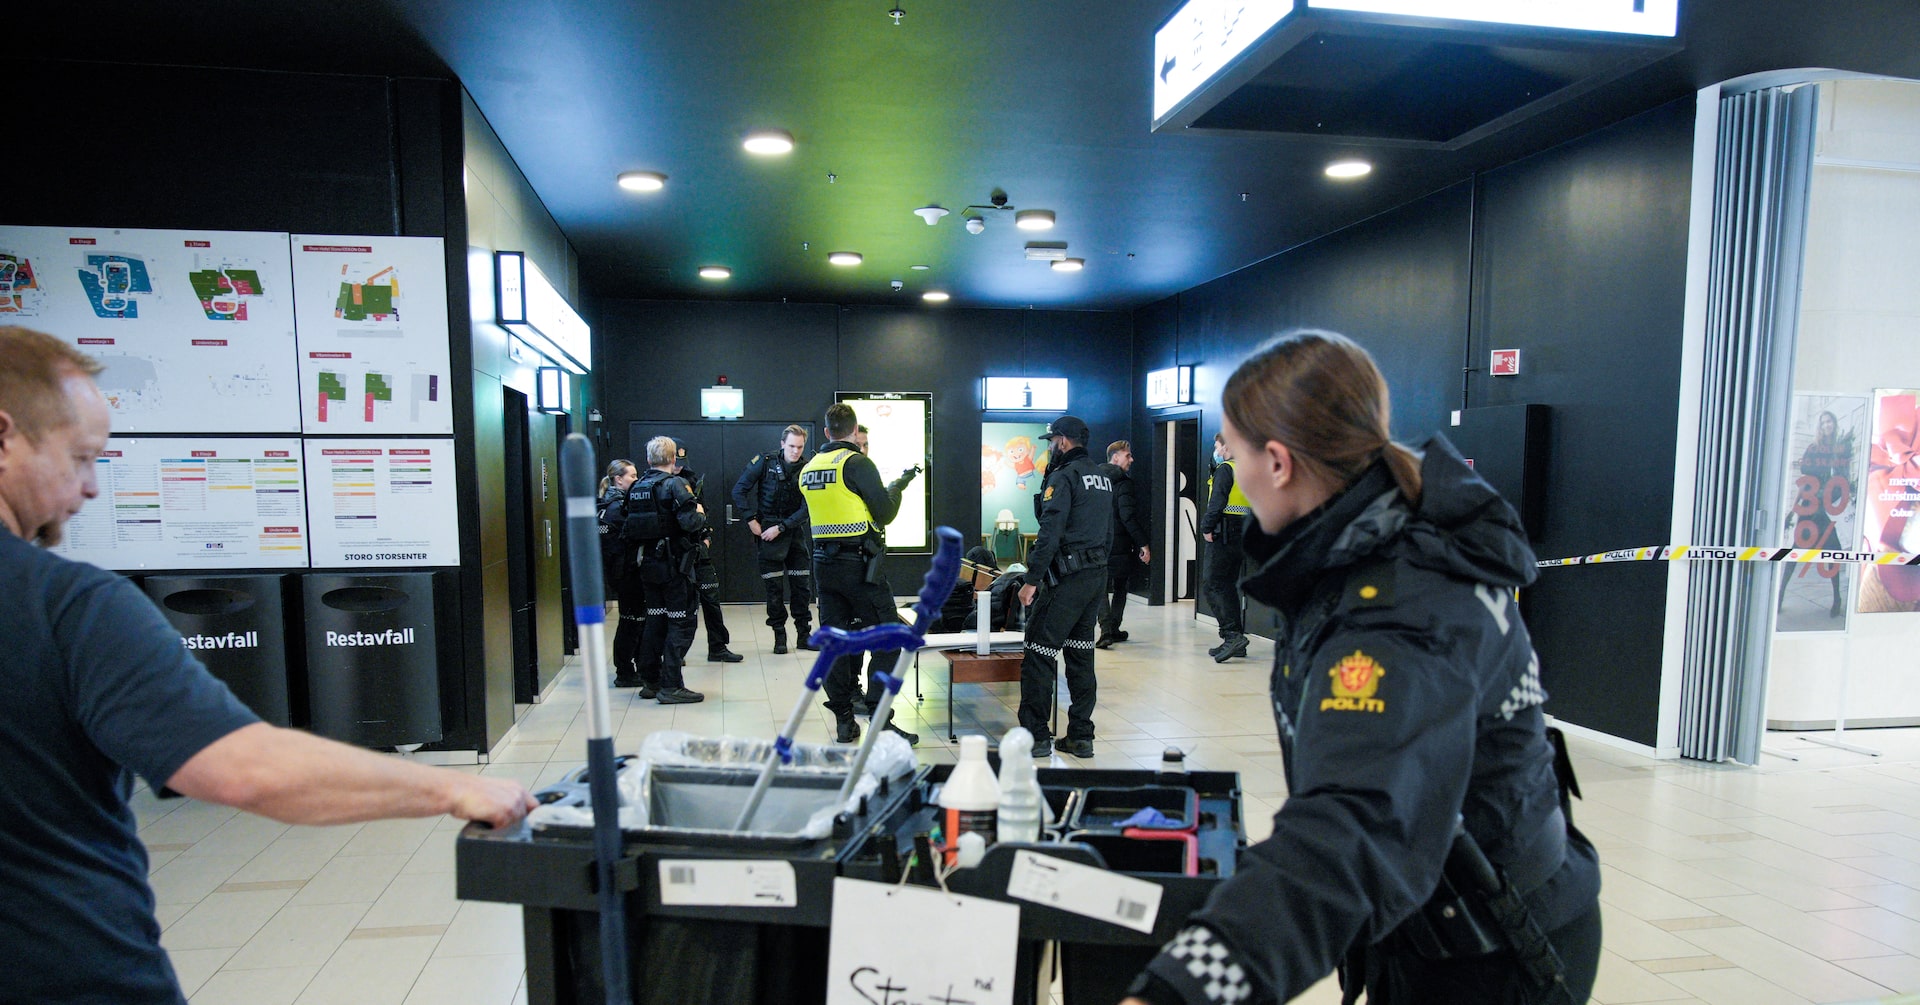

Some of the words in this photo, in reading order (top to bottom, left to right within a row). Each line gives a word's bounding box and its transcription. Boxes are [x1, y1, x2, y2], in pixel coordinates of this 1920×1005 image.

[801, 470, 836, 486] POLITI
[1082, 474, 1113, 492] POLIT
[1888, 478, 1919, 488] merry
[630, 491, 651, 500] POLITI
[1792, 474, 1850, 516] 30
[1879, 490, 1920, 501] christma
[1890, 508, 1914, 517] Cubus
[1604, 550, 1634, 559] POLITI
[1687, 549, 1737, 560] POLITI
[1794, 519, 1841, 579] %
[344, 553, 373, 561] STORO
[375, 552, 428, 560] STORSENTER
[1820, 551, 1875, 562] POLITI
[180, 631, 258, 650] estavfall
[326, 628, 415, 647] Restavfall
[1320, 698, 1385, 713] POLITI
